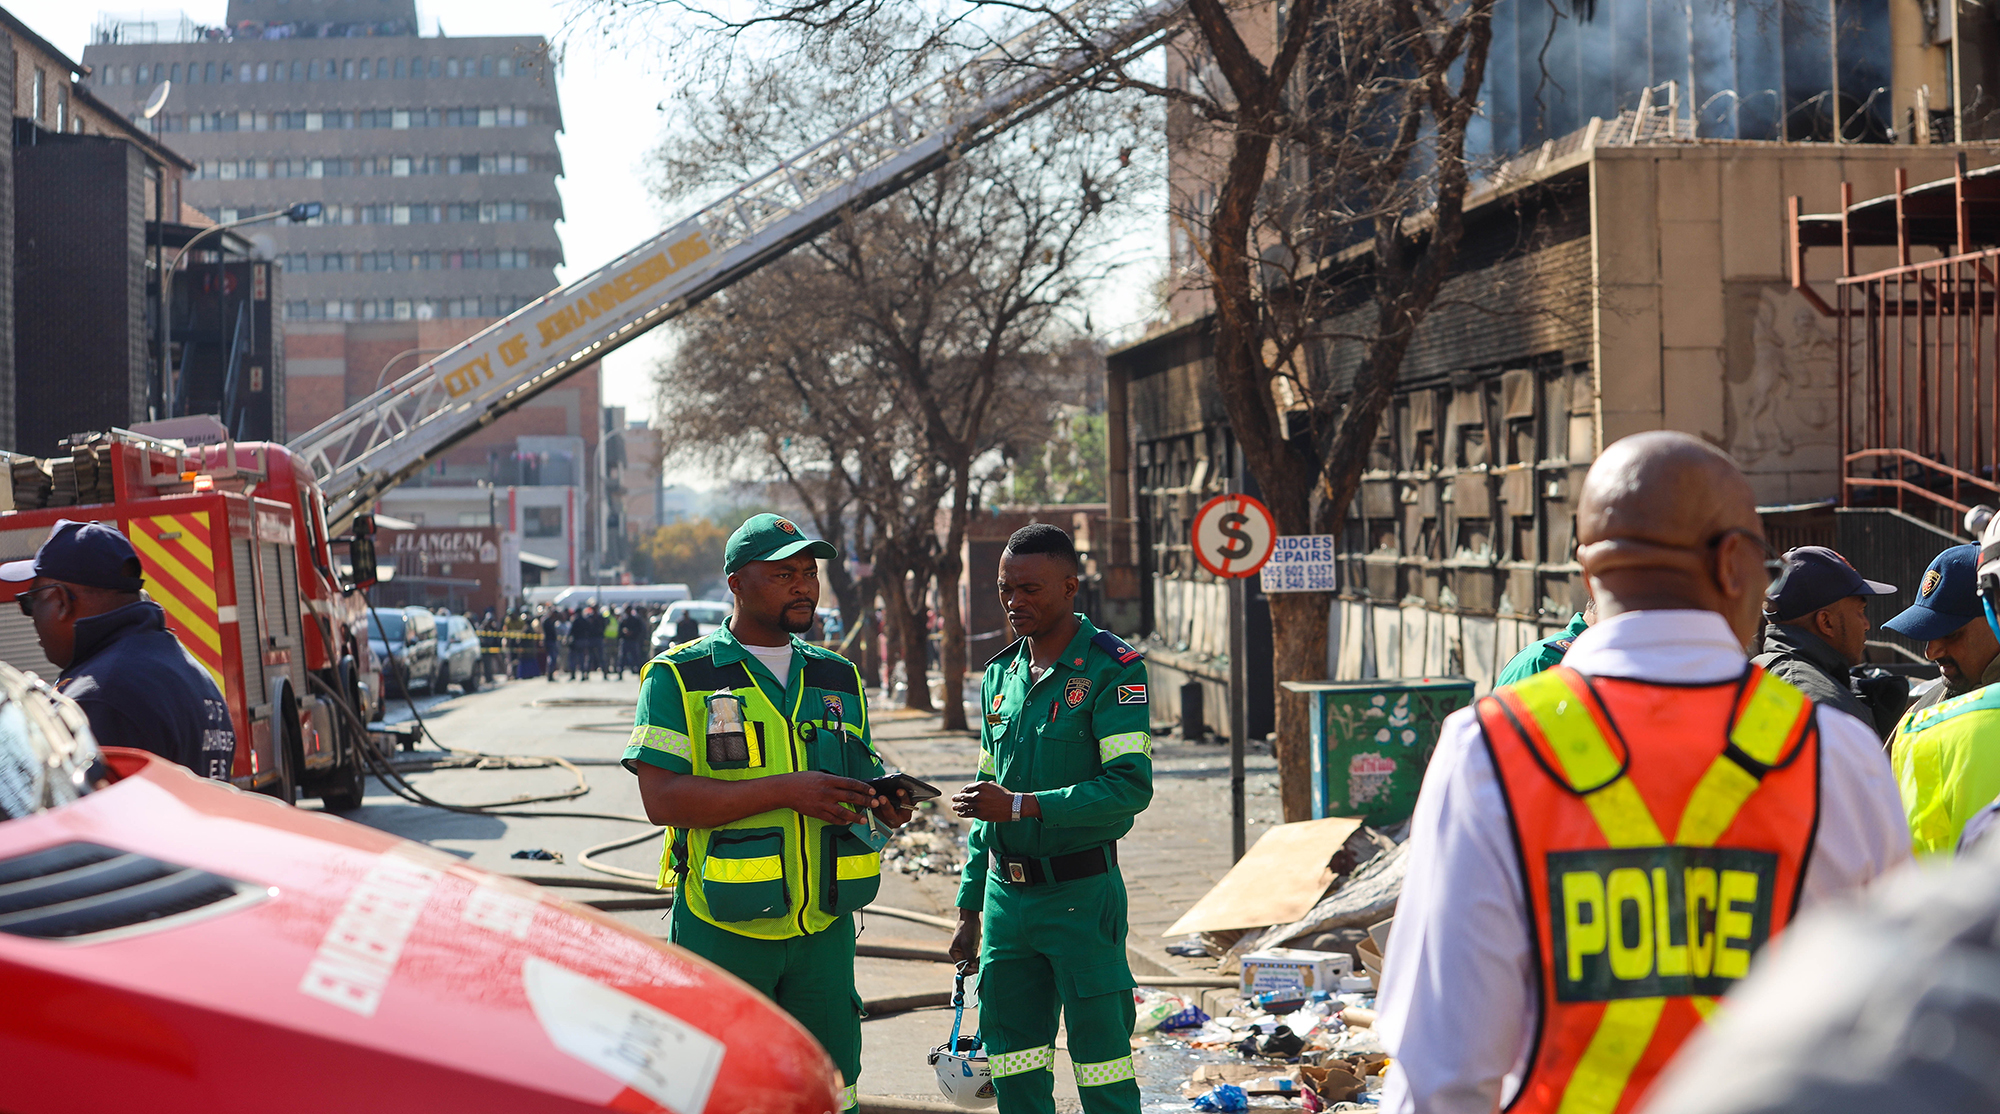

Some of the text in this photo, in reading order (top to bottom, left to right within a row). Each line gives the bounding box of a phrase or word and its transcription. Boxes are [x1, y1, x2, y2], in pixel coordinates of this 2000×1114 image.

[444, 230, 712, 399] CITY OF JOHANNESBURG
[395, 533, 482, 552] ELANGENI
[1216, 512, 1253, 560] S
[1275, 537, 1332, 549] RIDGES
[1269, 549, 1332, 563] EPAIRS
[1263, 563, 1332, 578] 065 602 6357
[1264, 578, 1282, 590] 074
[1286, 577, 1305, 590] 540
[1561, 866, 1759, 982] POLICE
